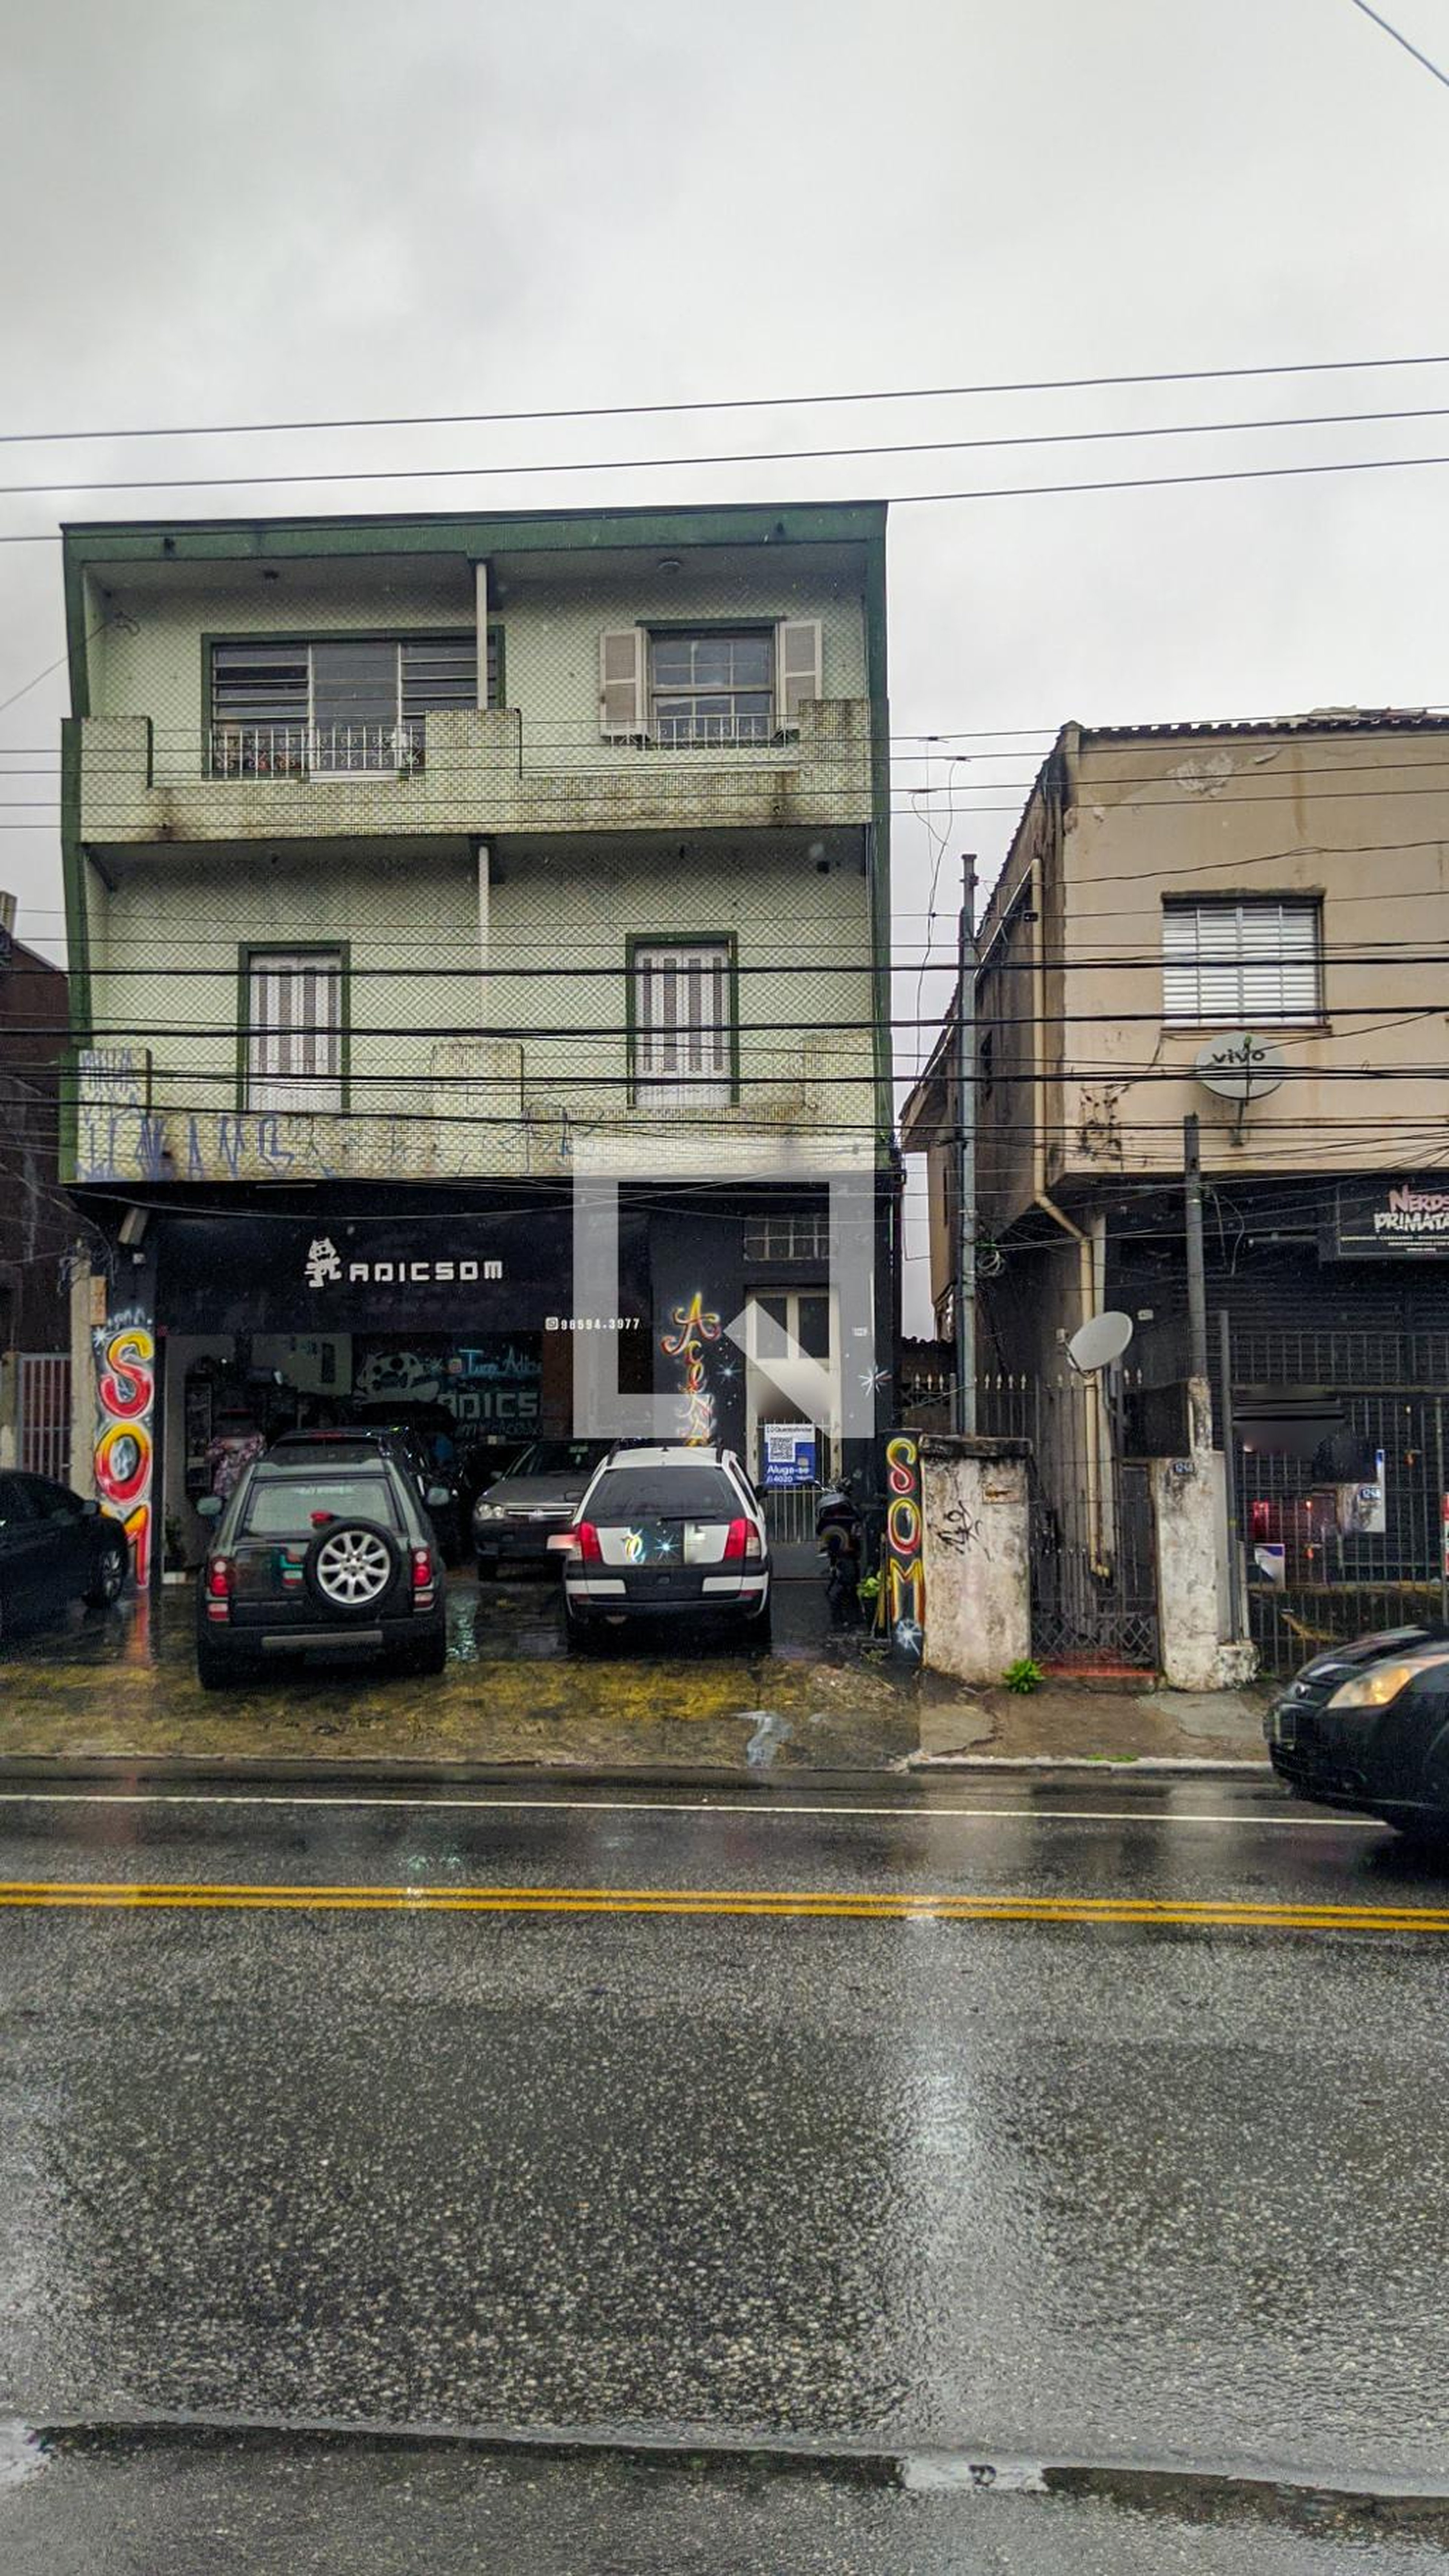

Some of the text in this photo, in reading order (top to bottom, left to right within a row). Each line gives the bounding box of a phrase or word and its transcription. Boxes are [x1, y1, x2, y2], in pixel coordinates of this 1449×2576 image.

[1212, 1049, 1266, 1064] vivo
[350, 1261, 502, 1281] ADICSOM
[887, 1437, 924, 1624] SOM
